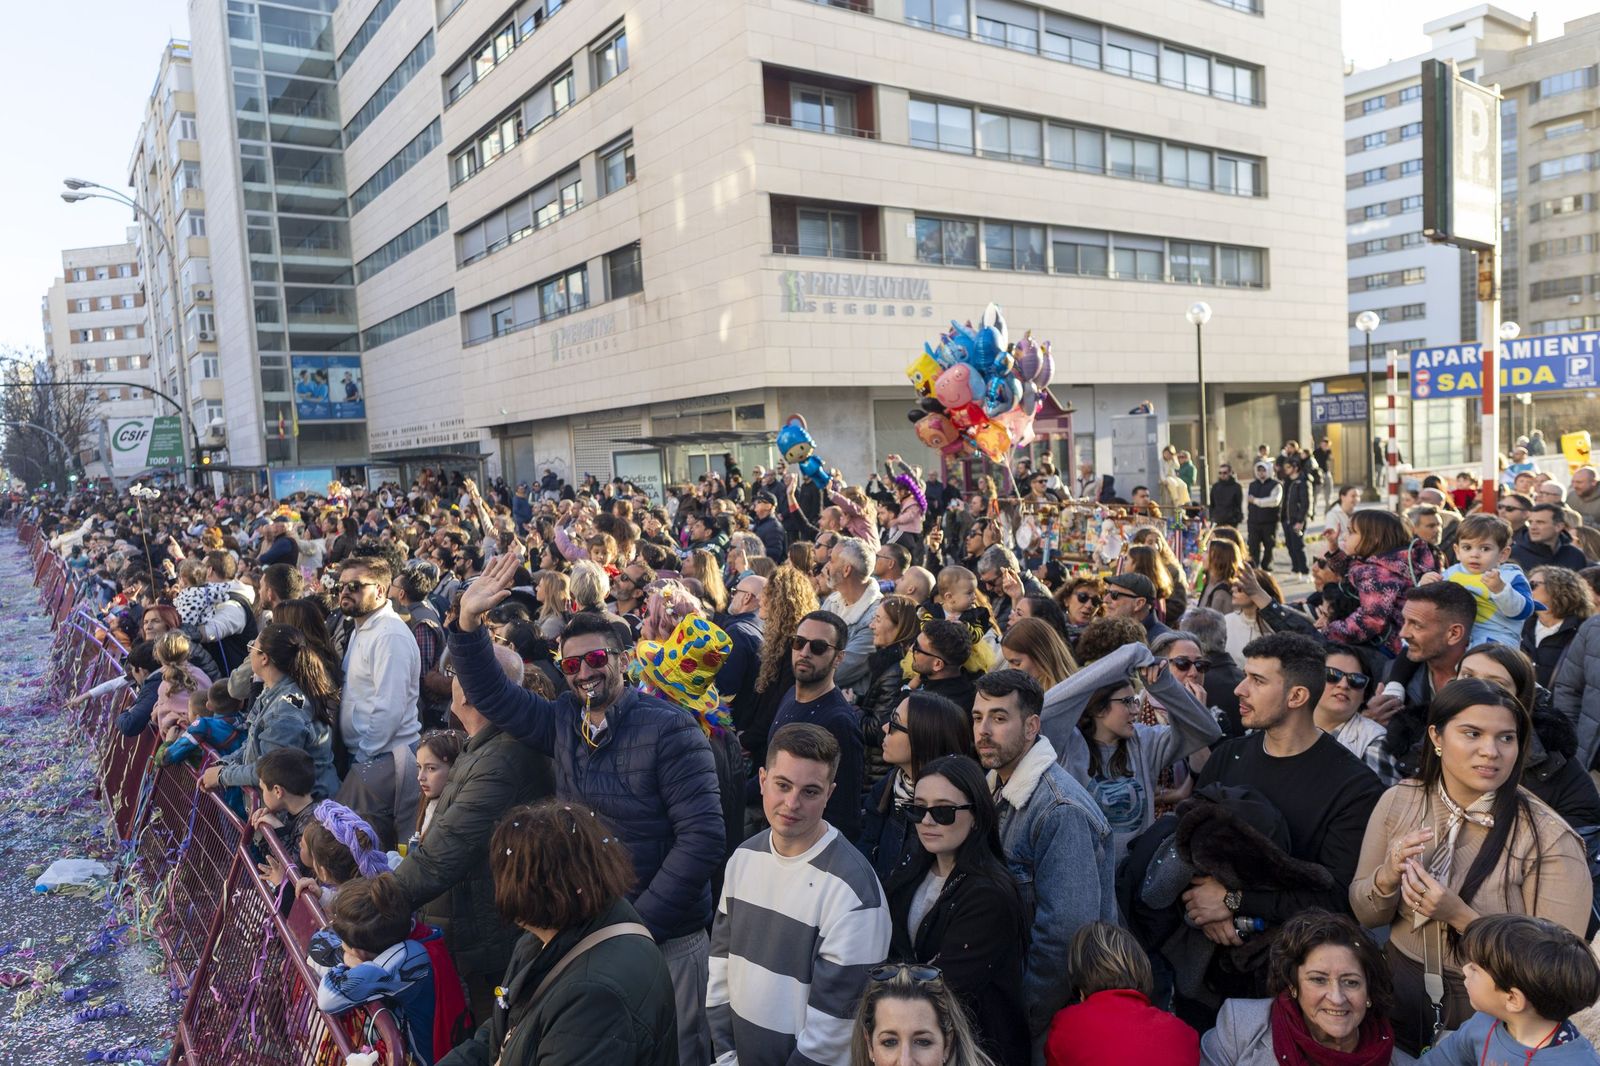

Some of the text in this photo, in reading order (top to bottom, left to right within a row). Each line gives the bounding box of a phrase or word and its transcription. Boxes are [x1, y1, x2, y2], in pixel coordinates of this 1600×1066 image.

[810, 271, 931, 300] PREVENTIVA
[803, 301, 933, 317] SEGUROS
[1416, 334, 1600, 368] APARAMIENT
[1571, 358, 1588, 375] P
[1437, 365, 1556, 391] SAIDA
[1316, 405, 1325, 420] P
[120, 430, 149, 442] CSIF
[149, 456, 170, 465] TODO
